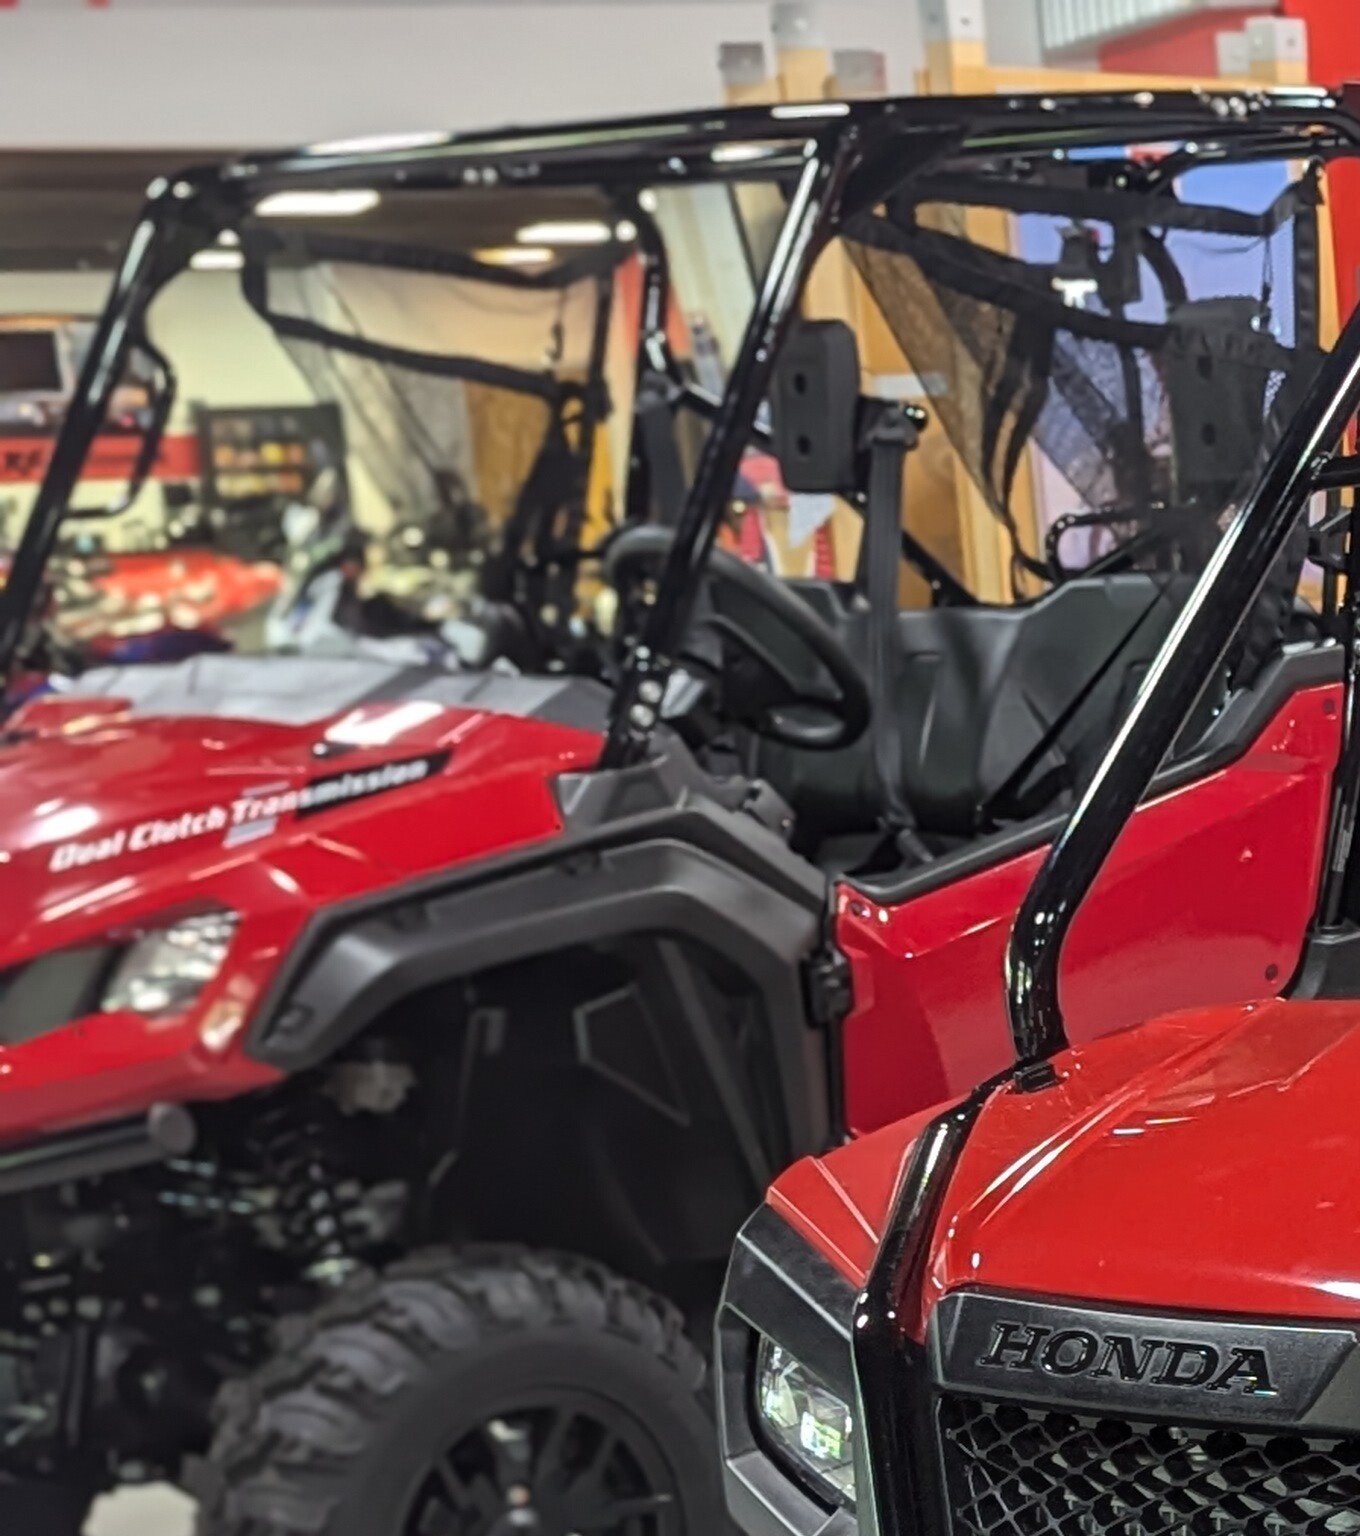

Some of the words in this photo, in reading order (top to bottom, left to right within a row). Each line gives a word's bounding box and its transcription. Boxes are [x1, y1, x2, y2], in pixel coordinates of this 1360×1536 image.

[49, 830, 124, 873] Dual
[128, 806, 226, 852] Clutch
[228, 759, 429, 825] Transmission
[976, 1320, 1279, 1397] HONDA
